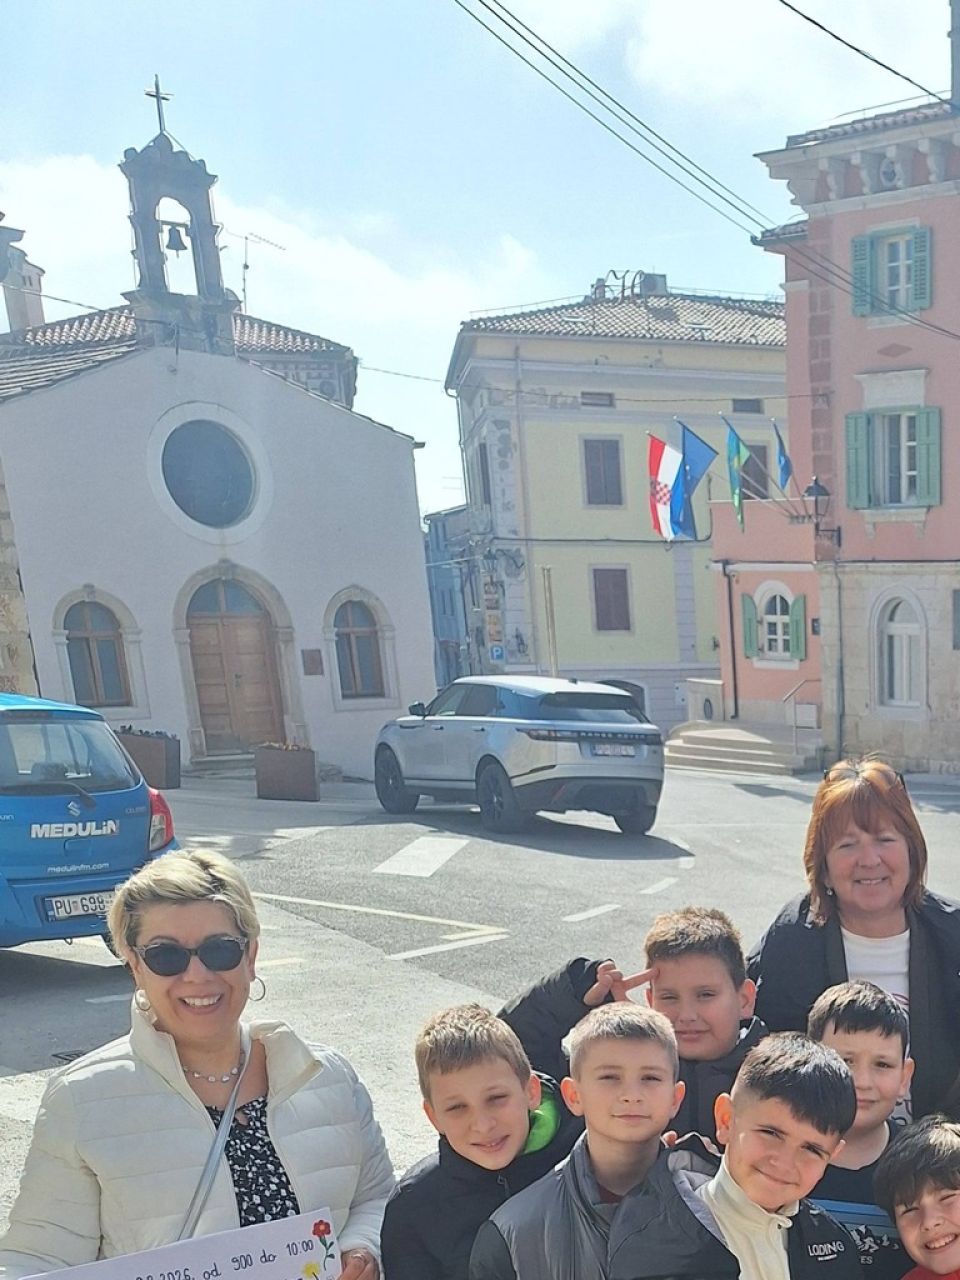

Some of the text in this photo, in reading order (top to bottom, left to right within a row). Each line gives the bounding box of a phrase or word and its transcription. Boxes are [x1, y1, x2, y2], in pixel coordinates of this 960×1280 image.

[47, 862, 110, 873] medulinfm.com
[55, 899, 73, 916] PU
[808, 1241, 845, 1257] LODING
[204, 1263, 221, 1280] od
[260, 1249, 277, 1263] do
[286, 1240, 314, 1256] 10:00
